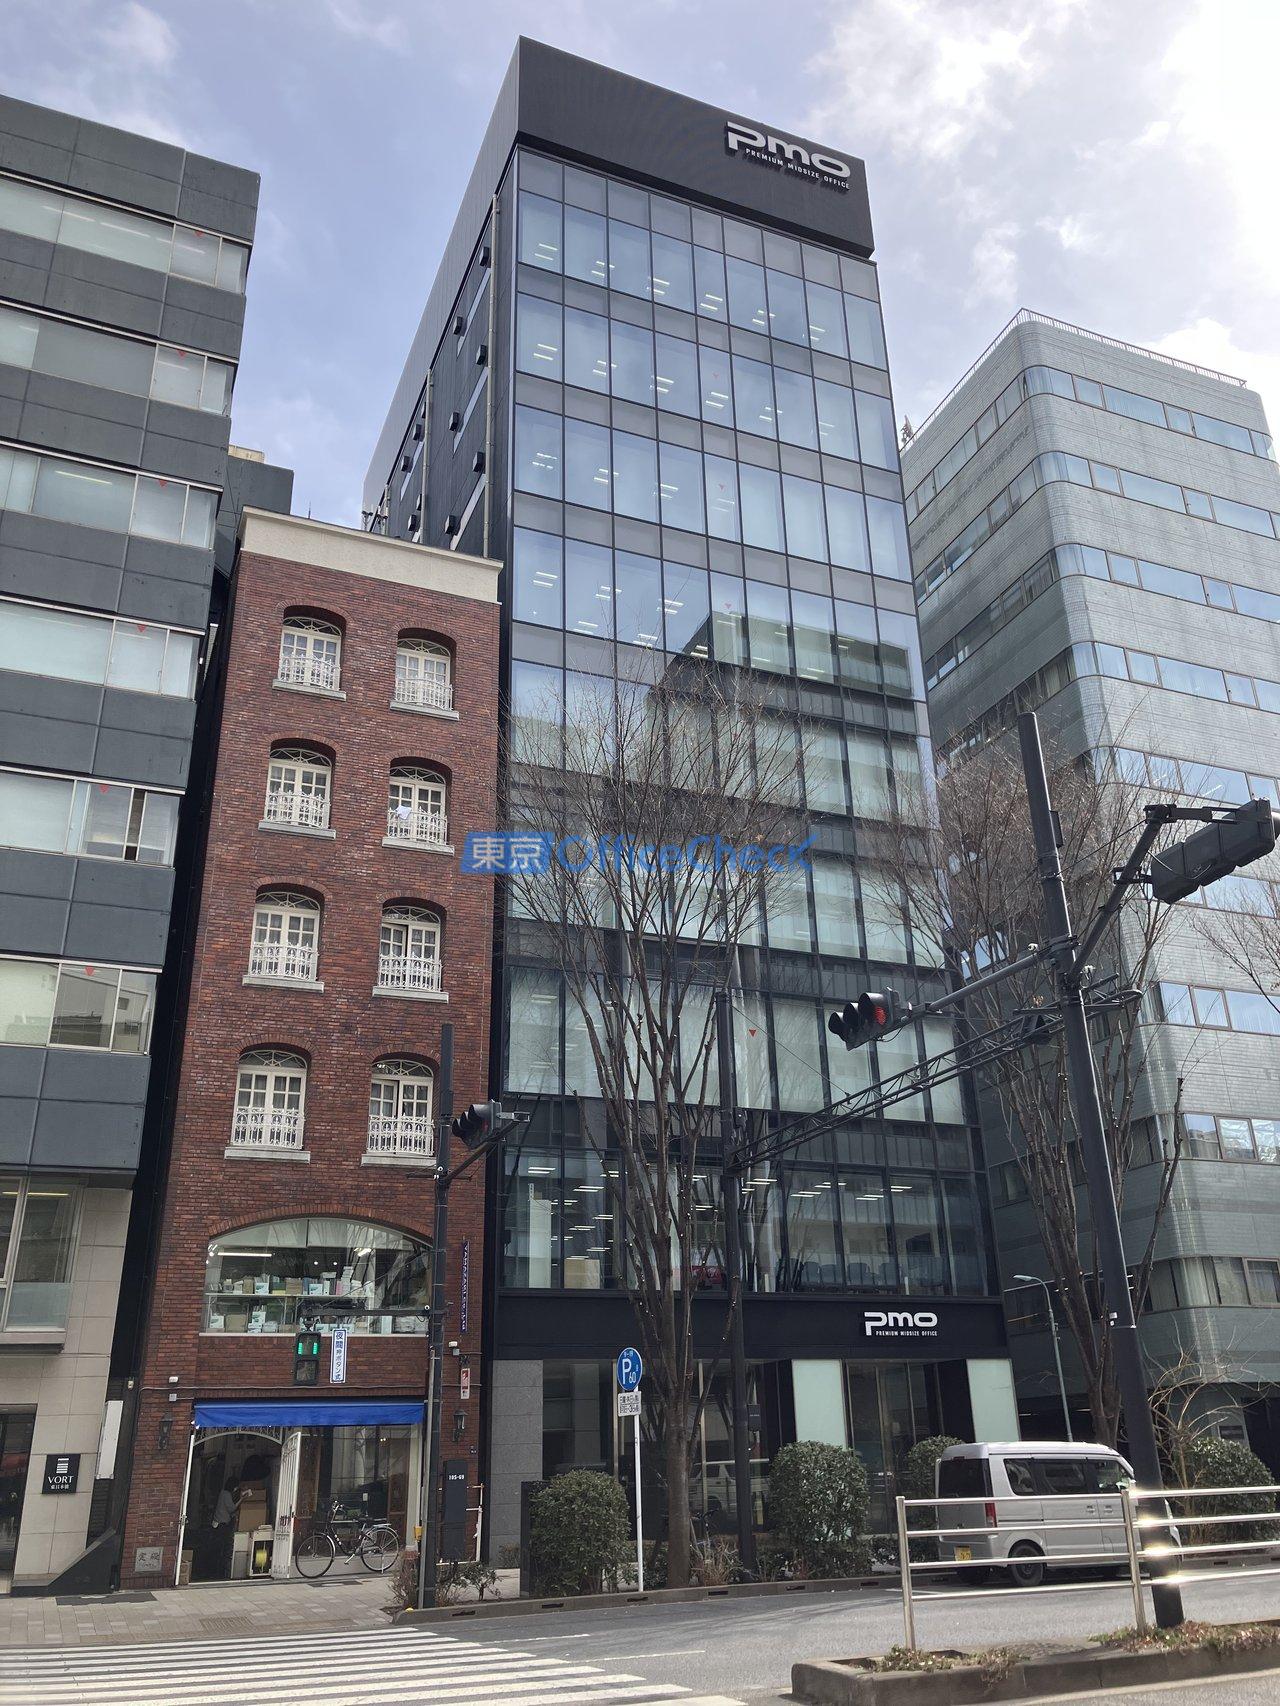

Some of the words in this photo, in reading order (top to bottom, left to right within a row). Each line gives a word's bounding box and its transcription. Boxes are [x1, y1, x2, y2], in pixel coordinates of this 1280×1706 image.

[745, 148, 784, 167] PREMIUM
[787, 163, 820, 179] MIDSIZE
[823, 176, 850, 190] OFFICE
[622, 1358, 632, 1384] P
[47, 1475, 74, 1484] VORT
